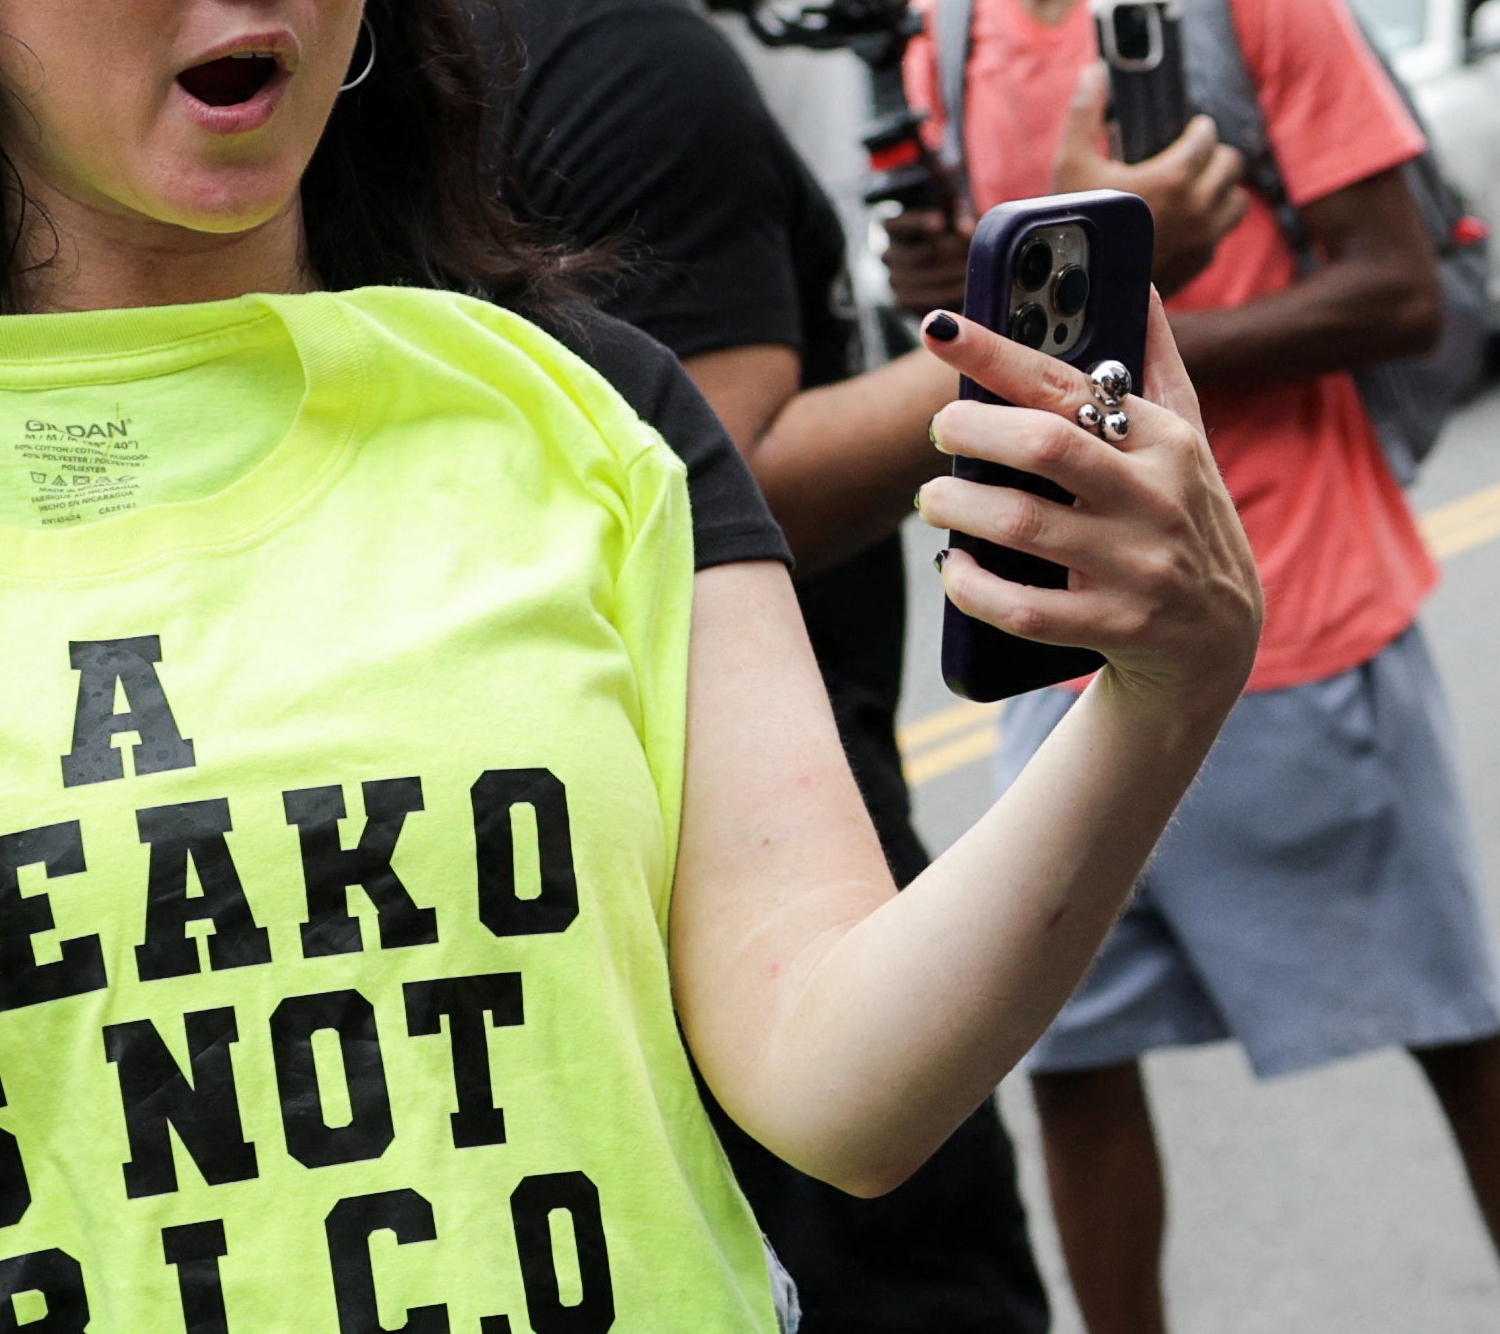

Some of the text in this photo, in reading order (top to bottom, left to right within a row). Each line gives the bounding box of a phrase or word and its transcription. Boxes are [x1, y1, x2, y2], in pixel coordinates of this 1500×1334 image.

[35, 445, 68, 453] COTTON
[42, 453, 88, 464] POLYESTER
[81, 490, 134, 505] NICARAGUA
[62, 635, 195, 788] A
[102, 971, 525, 1200] NOT
